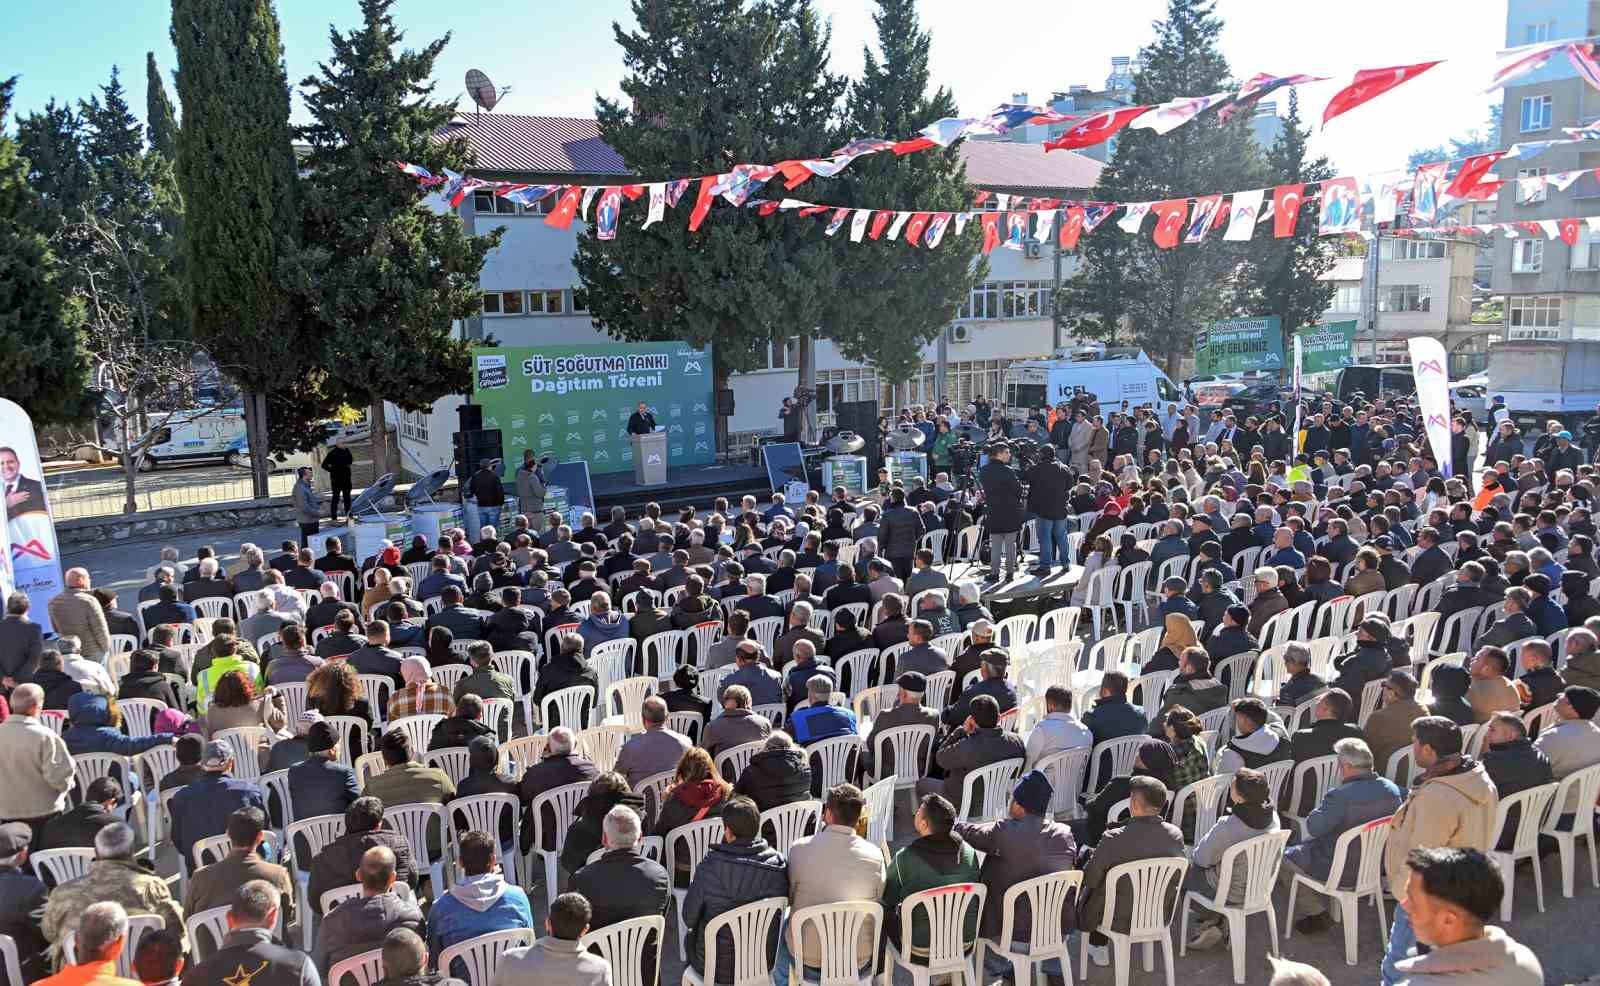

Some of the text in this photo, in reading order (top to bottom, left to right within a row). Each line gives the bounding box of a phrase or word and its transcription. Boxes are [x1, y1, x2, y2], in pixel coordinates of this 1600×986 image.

[523, 354, 668, 375] SÜT SOĞUTMA TANKI
[531, 371, 662, 394] Dağıtım Töreni
